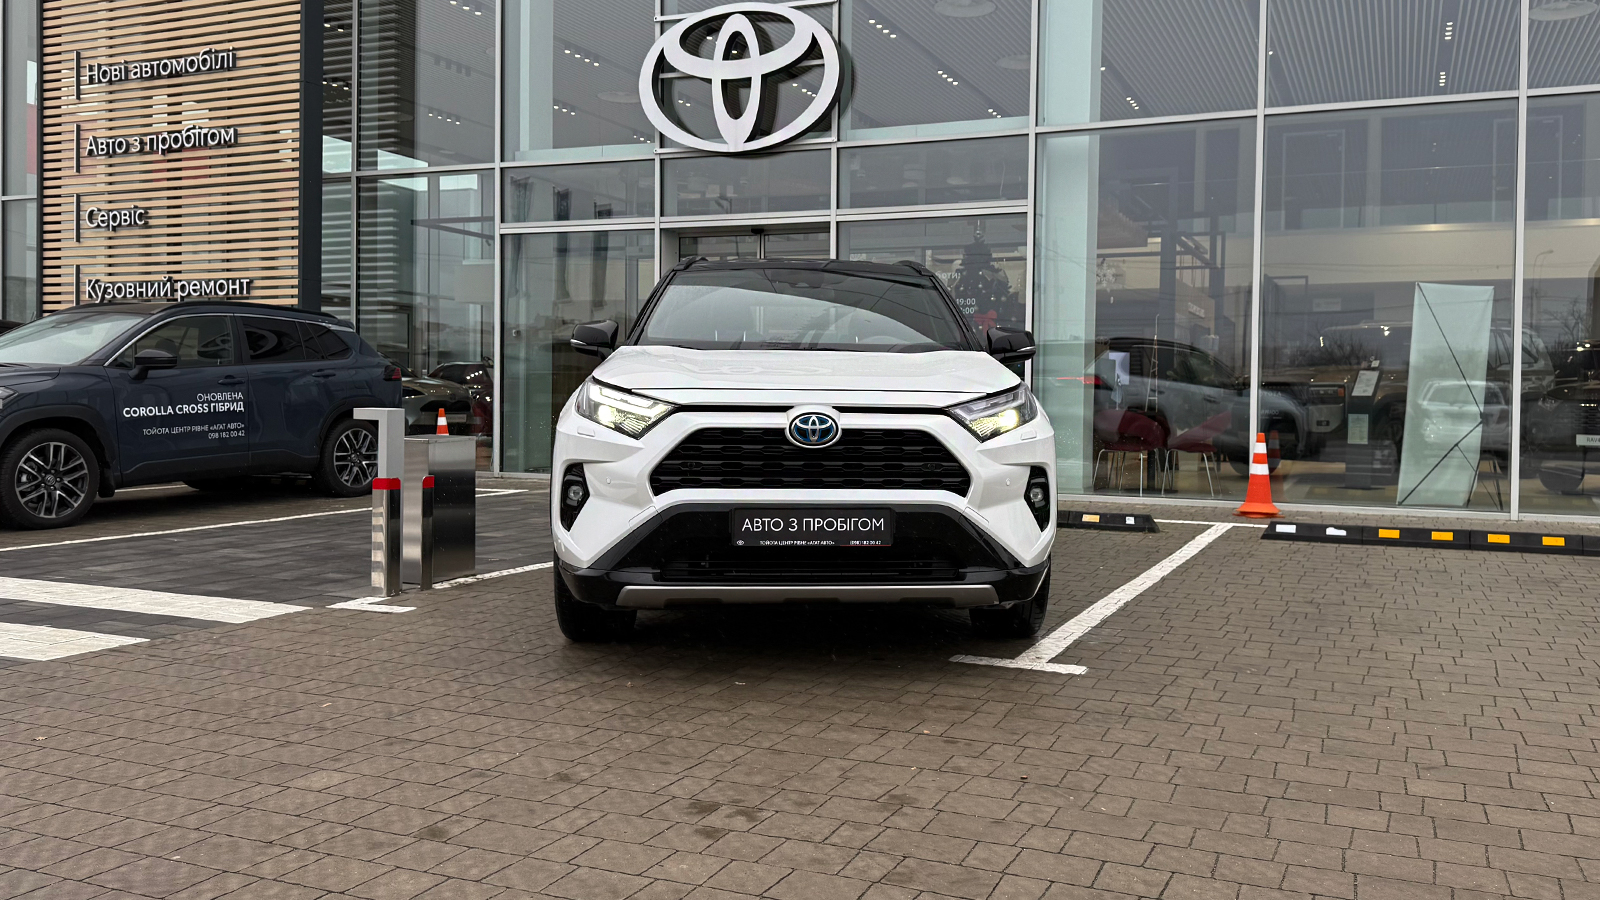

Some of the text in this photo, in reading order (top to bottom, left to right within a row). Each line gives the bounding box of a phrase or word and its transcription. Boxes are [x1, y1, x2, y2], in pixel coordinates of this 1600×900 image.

[86, 46, 234, 84] Нові автомобілі
[86, 124, 236, 156] Авто з пробігом
[85, 204, 146, 232] Сервіс
[85, 275, 250, 303] Кузовний ремонт
[196, 392, 244, 401] ОНОВЛЕНА
[123, 402, 245, 417] COROLLA CROSS ГІБРИД
[142, 427, 170, 435] ТОЙОТА
[170, 426, 191, 434] ЦЕНТР
[191, 424, 209, 432] РІВНЕ
[741, 518, 885, 531] АВТО З ПРОБІГОМ
